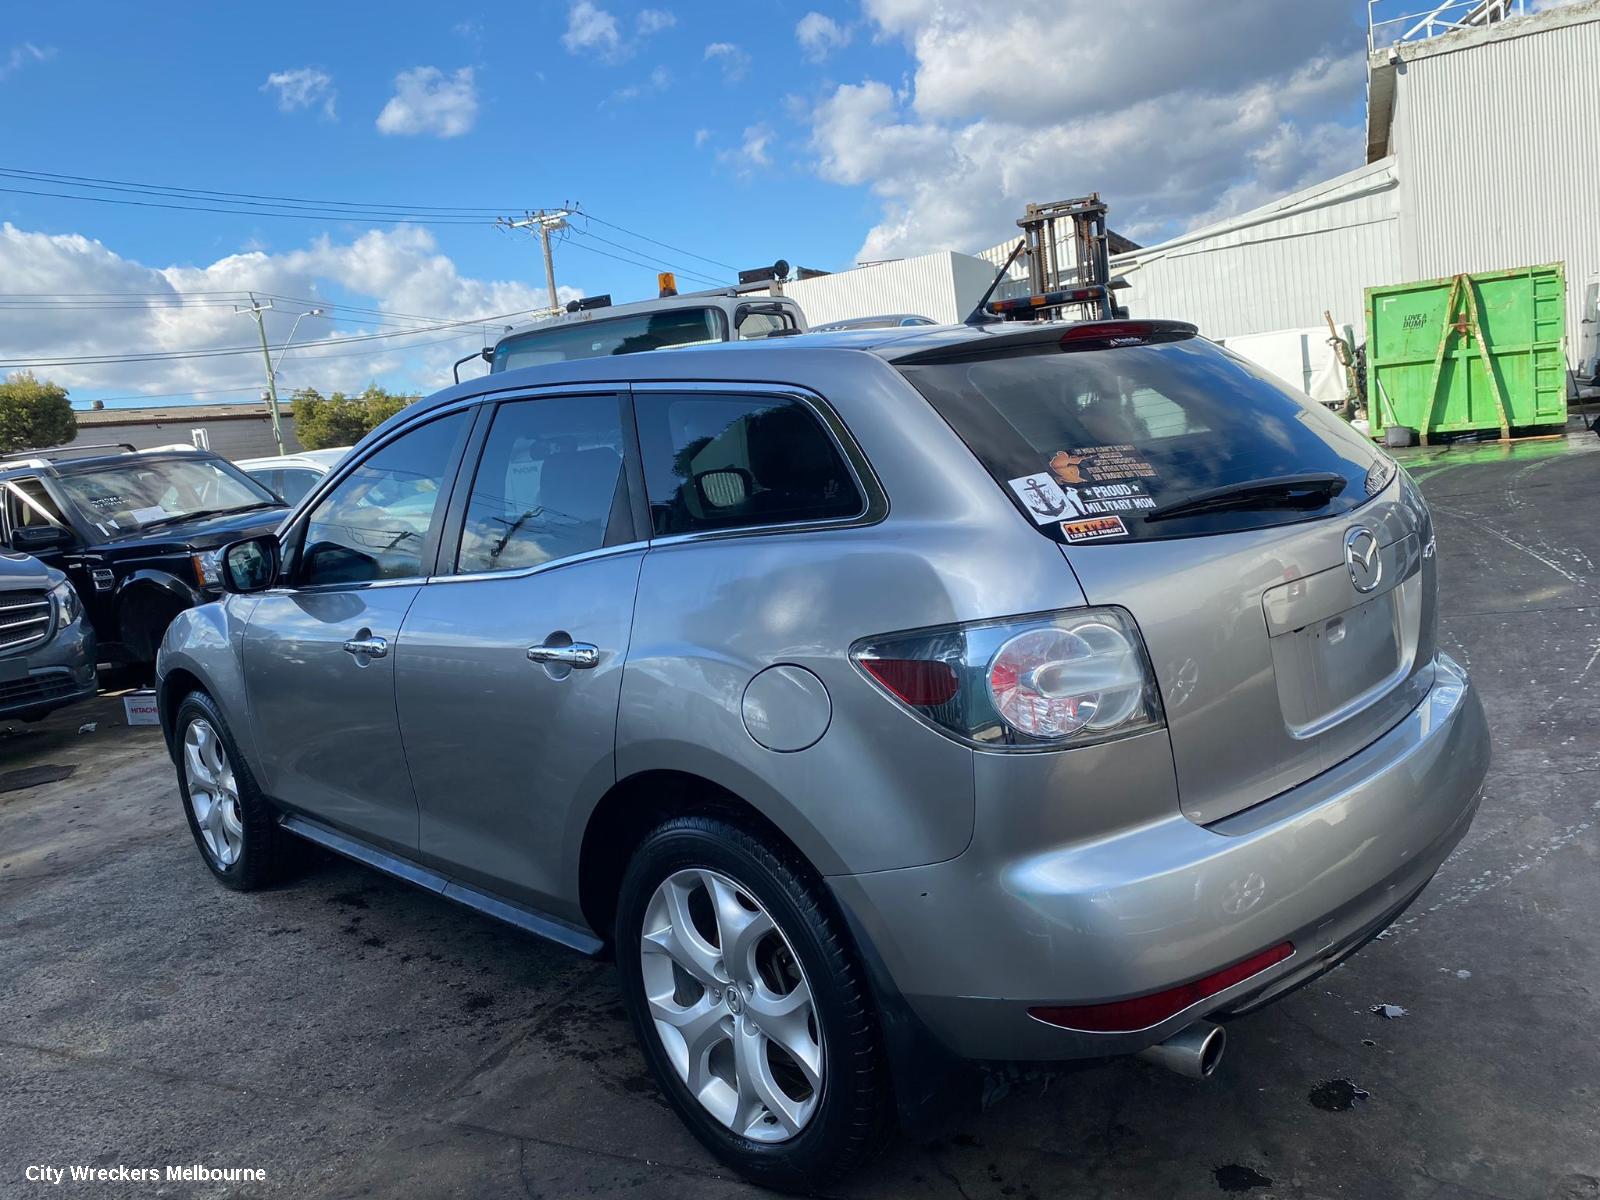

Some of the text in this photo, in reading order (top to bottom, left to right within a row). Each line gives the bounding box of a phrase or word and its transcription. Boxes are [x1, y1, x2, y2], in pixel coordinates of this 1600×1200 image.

[1403, 319, 1428, 328] DUMP
[1091, 484, 1132, 498] PROUD
[1085, 497, 1157, 514] MILITARY MOM
